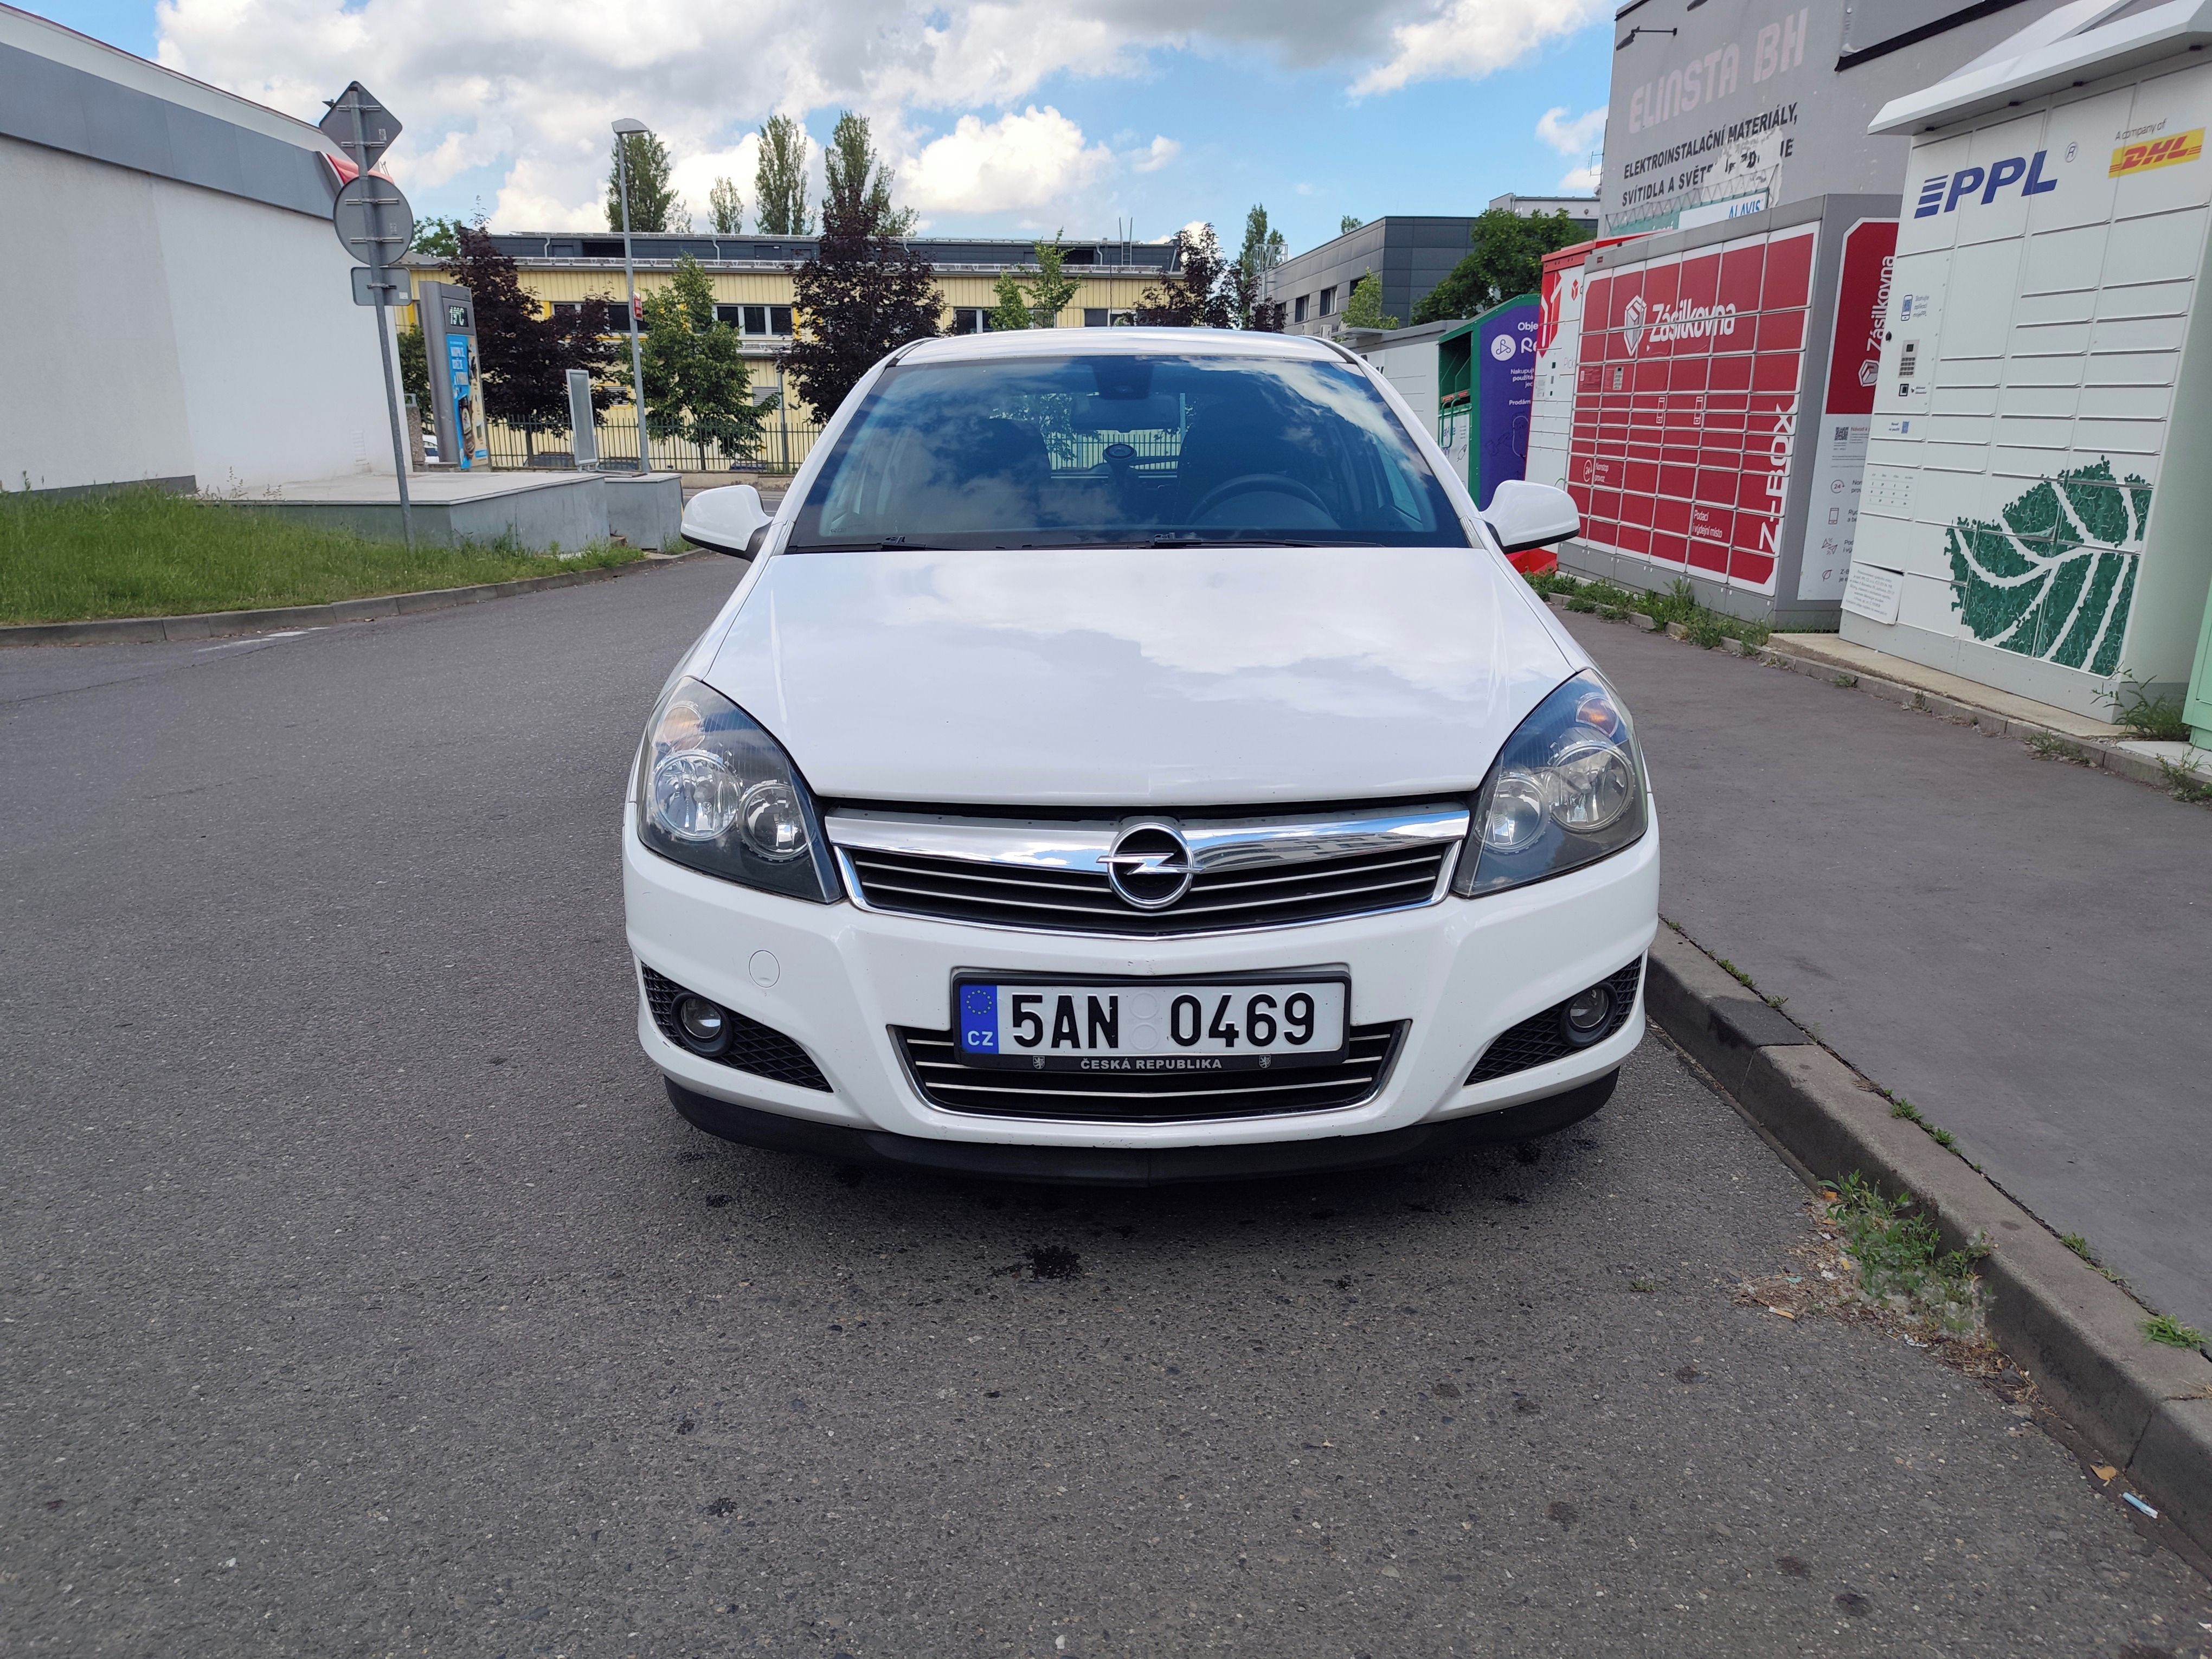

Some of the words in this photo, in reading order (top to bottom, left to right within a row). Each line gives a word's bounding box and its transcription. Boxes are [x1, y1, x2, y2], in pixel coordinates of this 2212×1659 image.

[1629, 43, 1739, 134] ELINSTA
[1753, 7, 1809, 84] BH
[1624, 124, 1726, 179] ELEKTROINSTALAČNÍ
[1727, 102, 1798, 144] MATERIÁLY,
[2120, 136, 2188, 170] DHL
[2121, 123, 2156, 140] company
[2157, 118, 2168, 131] of
[1622, 180, 1664, 207] SVÍTIDLA
[1668, 177, 1675, 194] A
[1943, 150, 2058, 213] PPL
[1649, 298, 1736, 343] Zásilkovna
[1758, 403, 1792, 553] Z-BOX
[967, 1030, 994, 1046] CZ
[1012, 993, 1119, 1049] 5AN
[1170, 992, 1315, 1048] 0469
[1081, 1057, 1131, 1070] ČESKÁ
[1135, 1058, 1222, 1070] REPUBLIKA
